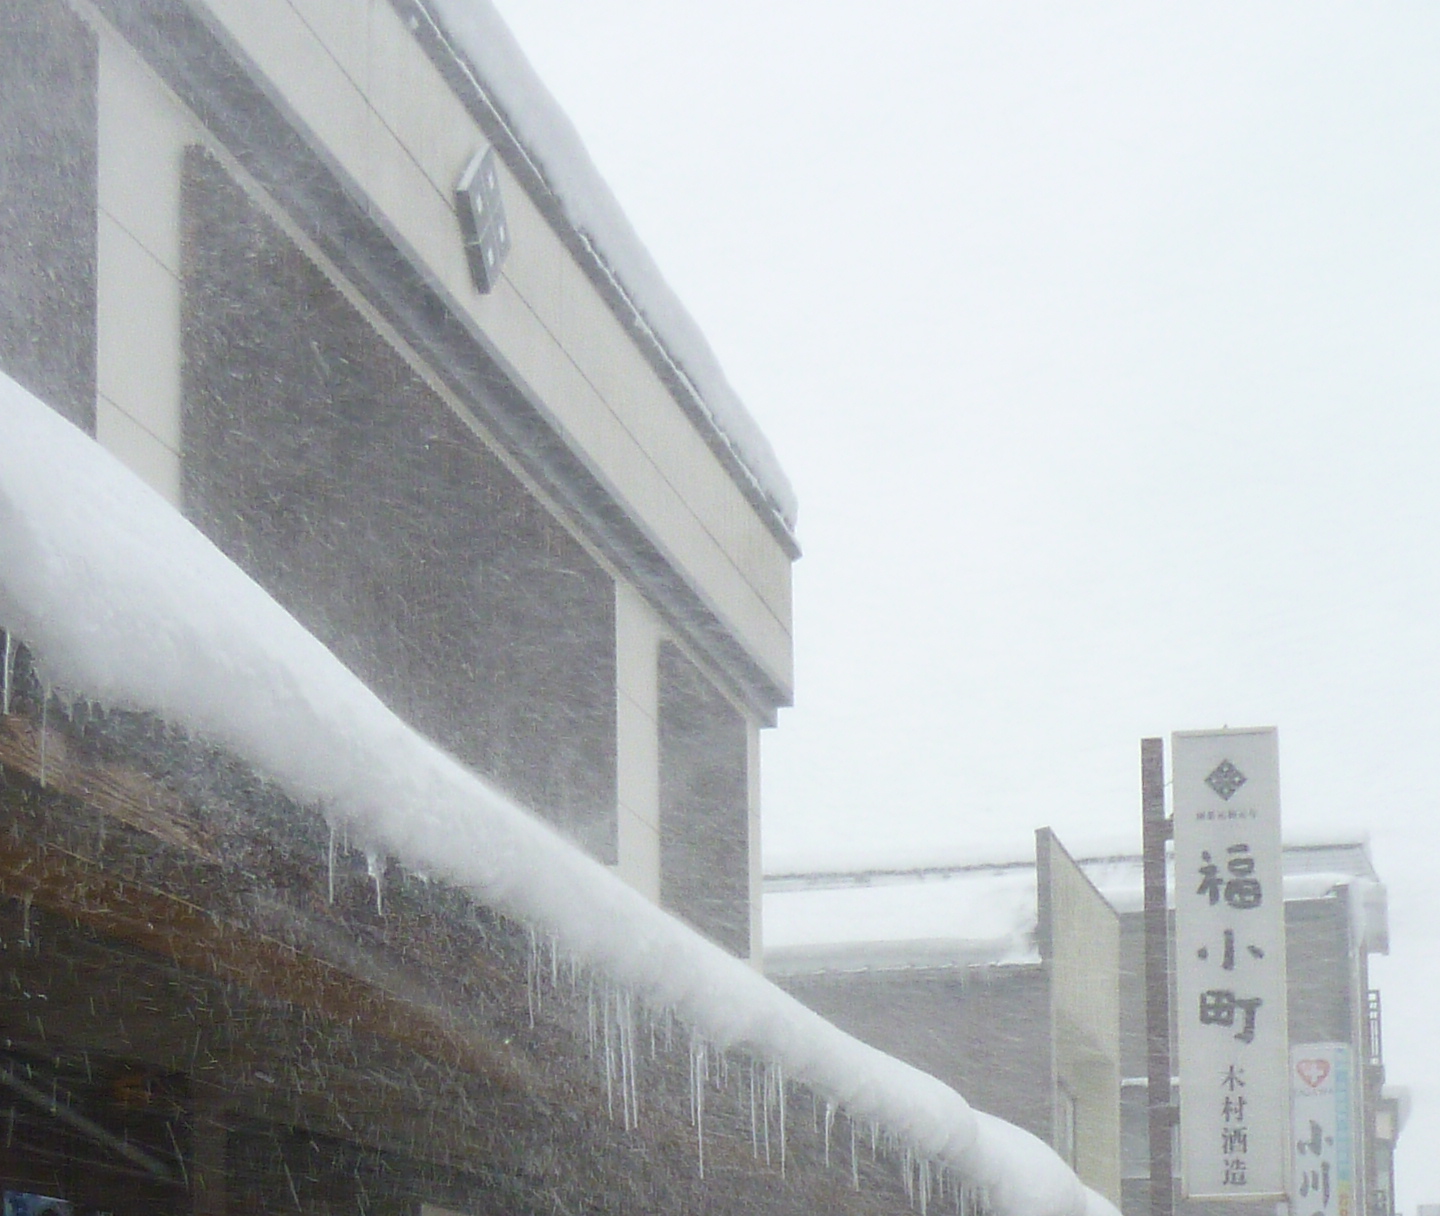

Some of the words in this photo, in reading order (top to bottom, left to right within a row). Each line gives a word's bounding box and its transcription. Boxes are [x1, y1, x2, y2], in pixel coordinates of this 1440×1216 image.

[1196, 843, 1264, 1043] 福小町
[1220, 1064, 1248, 1187] 木村酒造
